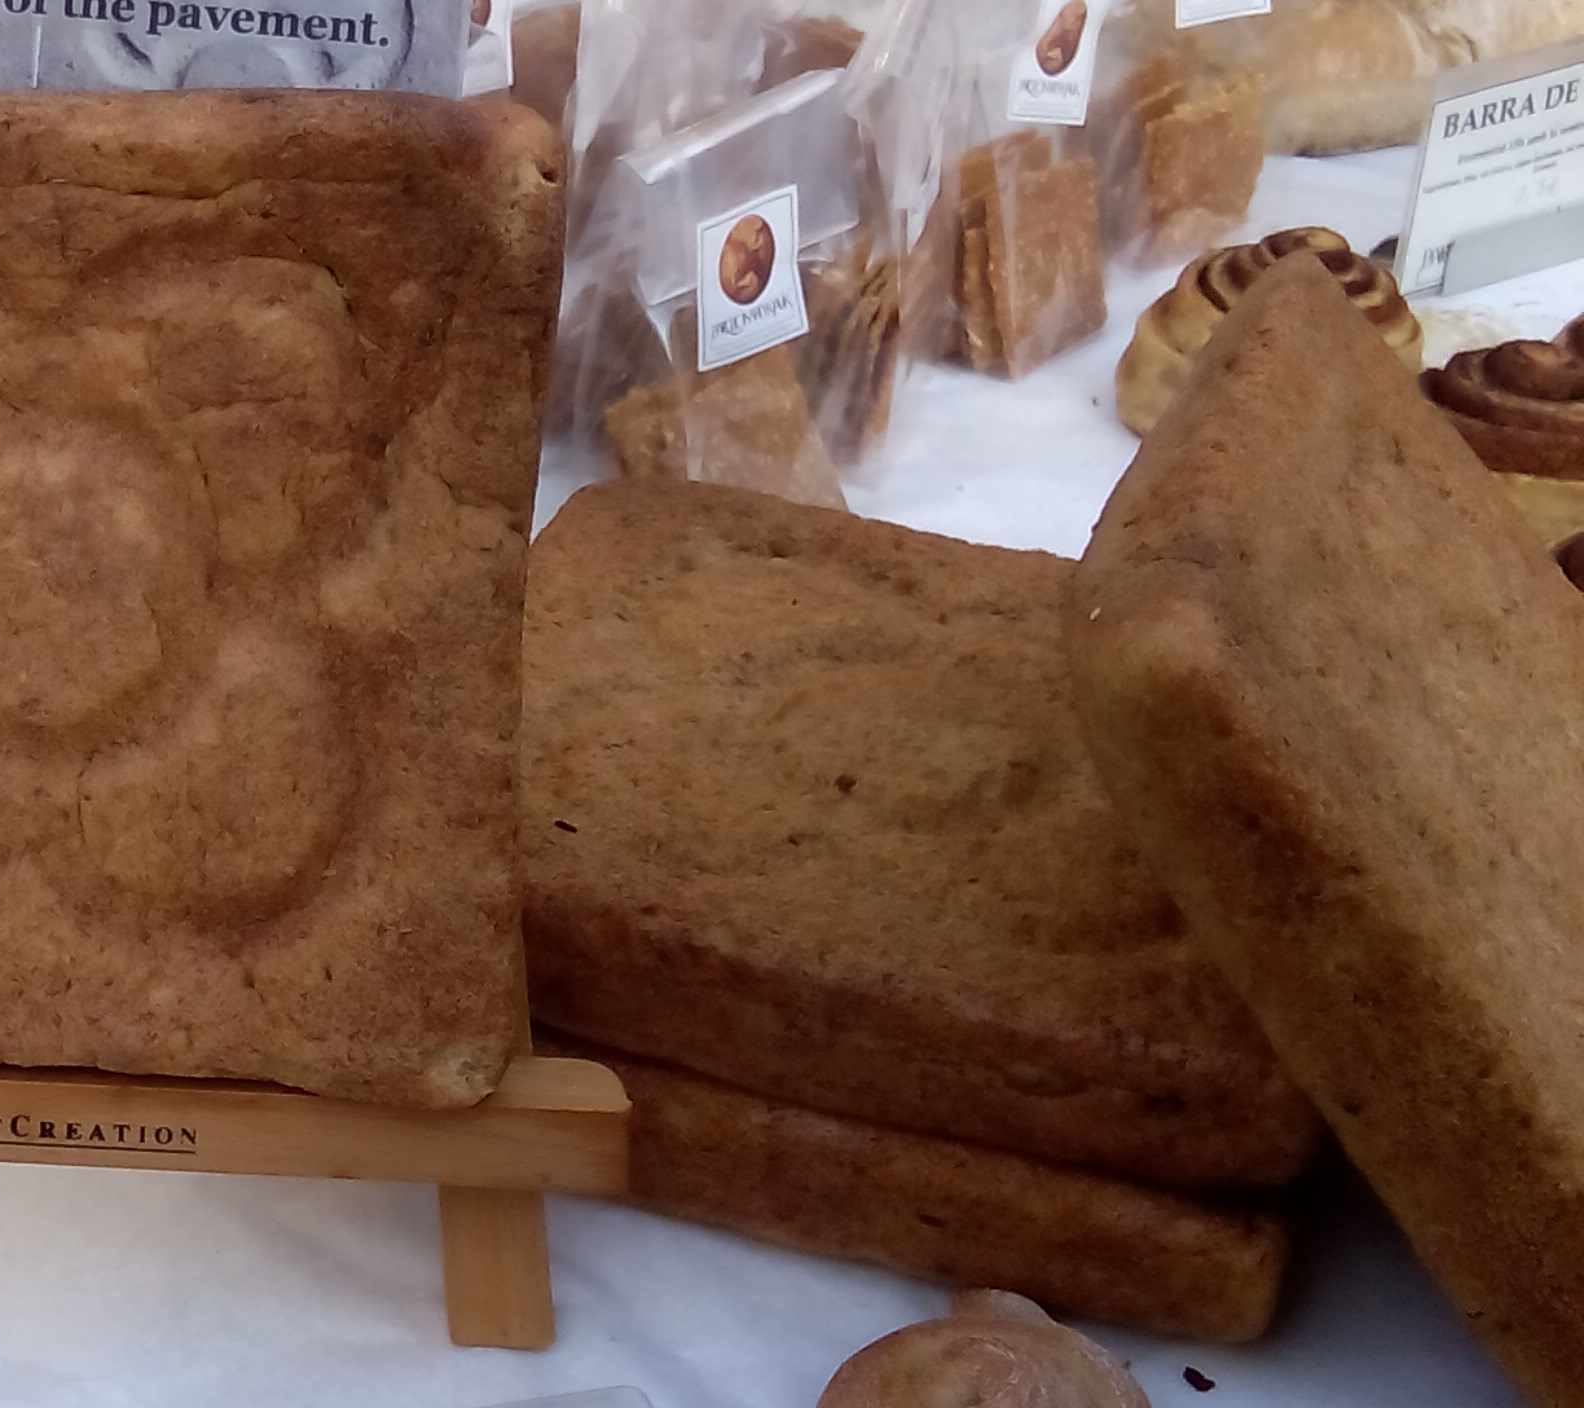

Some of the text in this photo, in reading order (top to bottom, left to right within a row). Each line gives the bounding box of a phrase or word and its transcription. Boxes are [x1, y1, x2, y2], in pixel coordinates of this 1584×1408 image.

[147, 0, 390, 47] pavement.
[1442, 77, 1582, 139] BARRA DE
